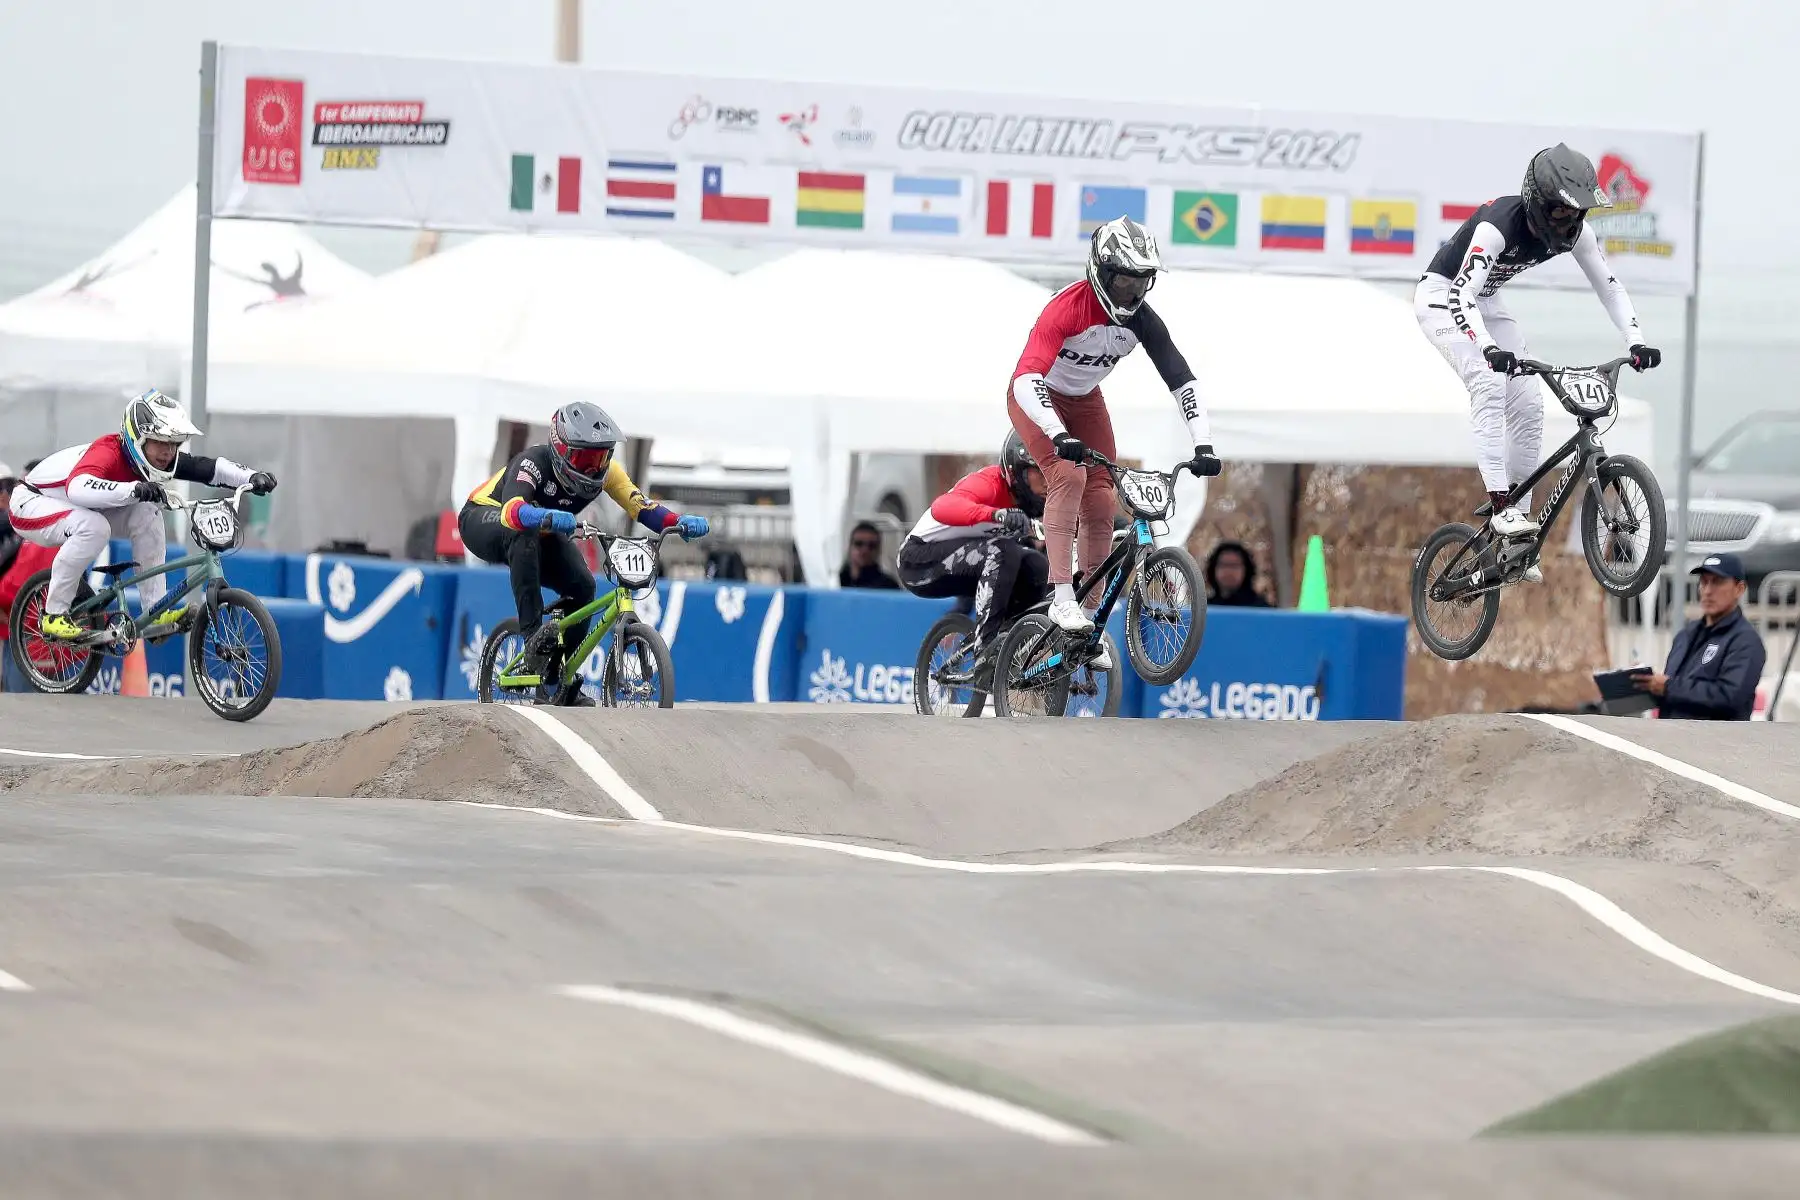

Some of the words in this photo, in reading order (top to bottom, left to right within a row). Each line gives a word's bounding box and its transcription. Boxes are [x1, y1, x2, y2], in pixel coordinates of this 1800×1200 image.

[340, 104, 420, 122] CAMPEONATO
[318, 123, 447, 144] IBEROAMERICANO
[898, 110, 996, 154] COPA
[992, 114, 1114, 159] LATINA
[1257, 128, 1361, 173] 2024
[322, 148, 380, 169] BMX
[1031, 379, 1053, 408] PERU
[1574, 383, 1606, 403] 141
[1181, 387, 1200, 422] PERU
[83, 479, 119, 491] PERU
[1136, 484, 1163, 503] 160
[207, 515, 230, 536] 159
[625, 553, 645, 572] 111
[853, 661, 915, 704] LEGA
